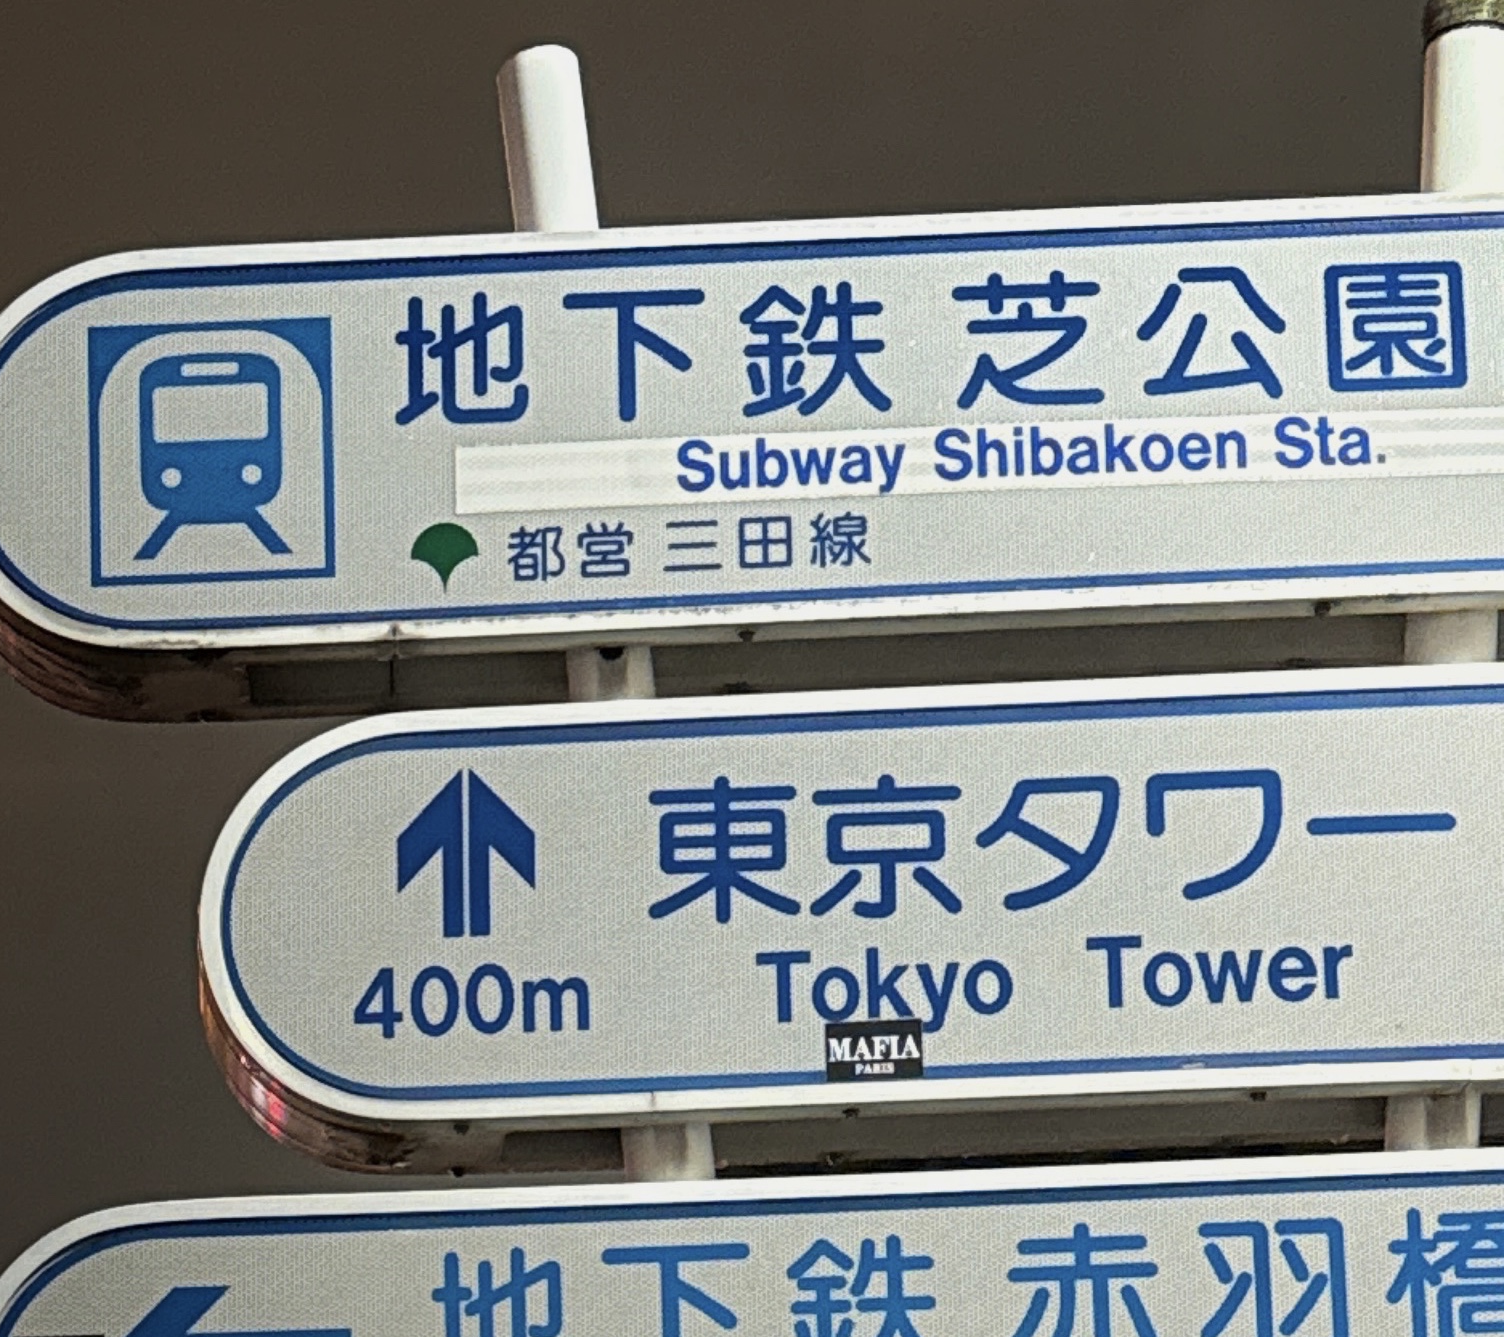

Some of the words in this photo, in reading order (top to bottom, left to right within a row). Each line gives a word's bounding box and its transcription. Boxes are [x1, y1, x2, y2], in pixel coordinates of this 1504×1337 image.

[396, 286, 891, 427] 地下鉄
[953, 260, 1468, 408] 芝公園
[676, 438, 906, 495] Subway
[933, 421, 1248, 483] Shibakoen
[1275, 412, 1387, 467] Sta.
[507, 522, 633, 584] 都営
[663, 512, 872, 573] 三田線
[647, 768, 1458, 923] 東京タワー
[354, 964, 591, 1038] 400m
[756, 947, 1014, 1032] Tokyo
[1087, 936, 1353, 1008] Tower
[827, 1034, 920, 1062] MAFIA
